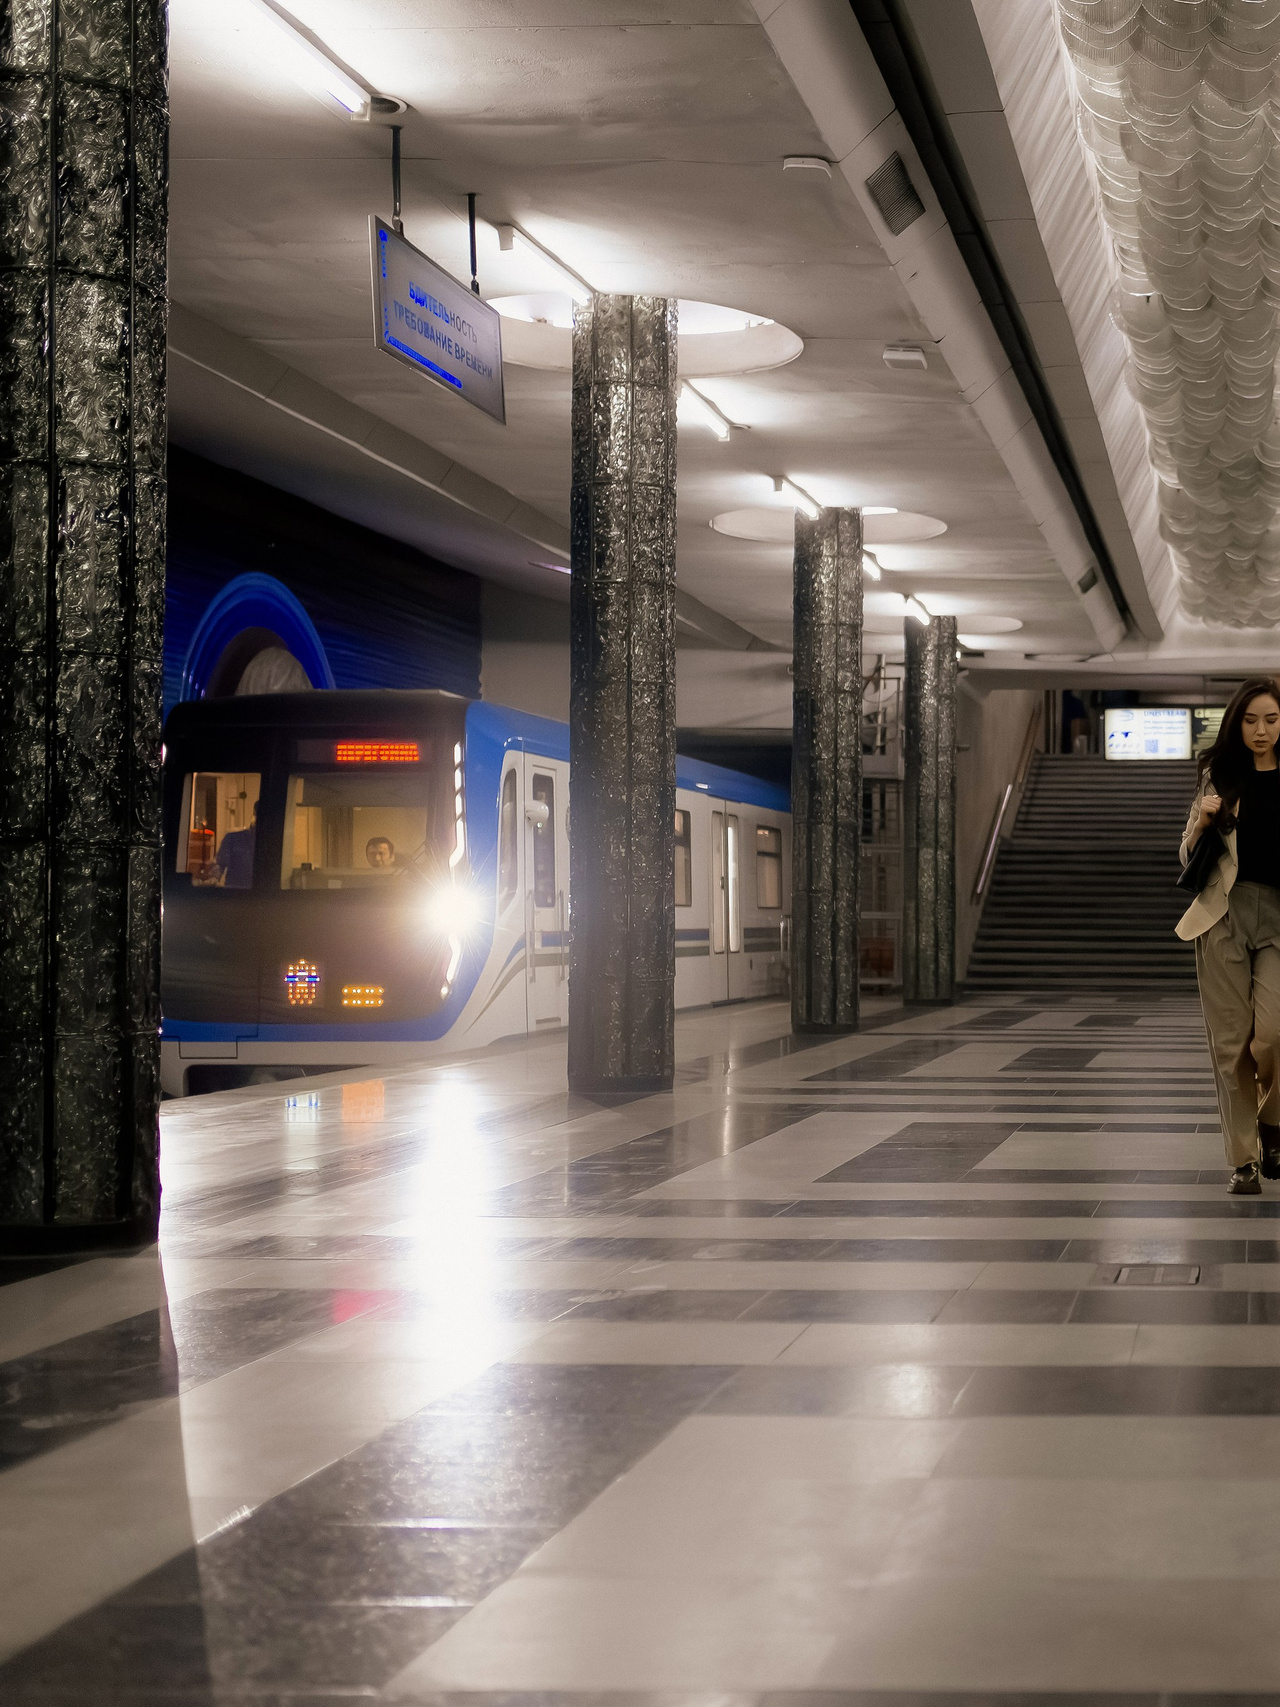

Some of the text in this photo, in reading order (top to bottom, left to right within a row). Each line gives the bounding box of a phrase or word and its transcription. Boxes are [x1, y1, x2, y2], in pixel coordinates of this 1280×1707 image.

[393, 300, 453, 356] ТРЕБОВАНИЕ
[454, 341, 494, 381] ВРЕМЕНИ
[408, 281, 478, 344] БДИТЕЛЬНОСТЬ
